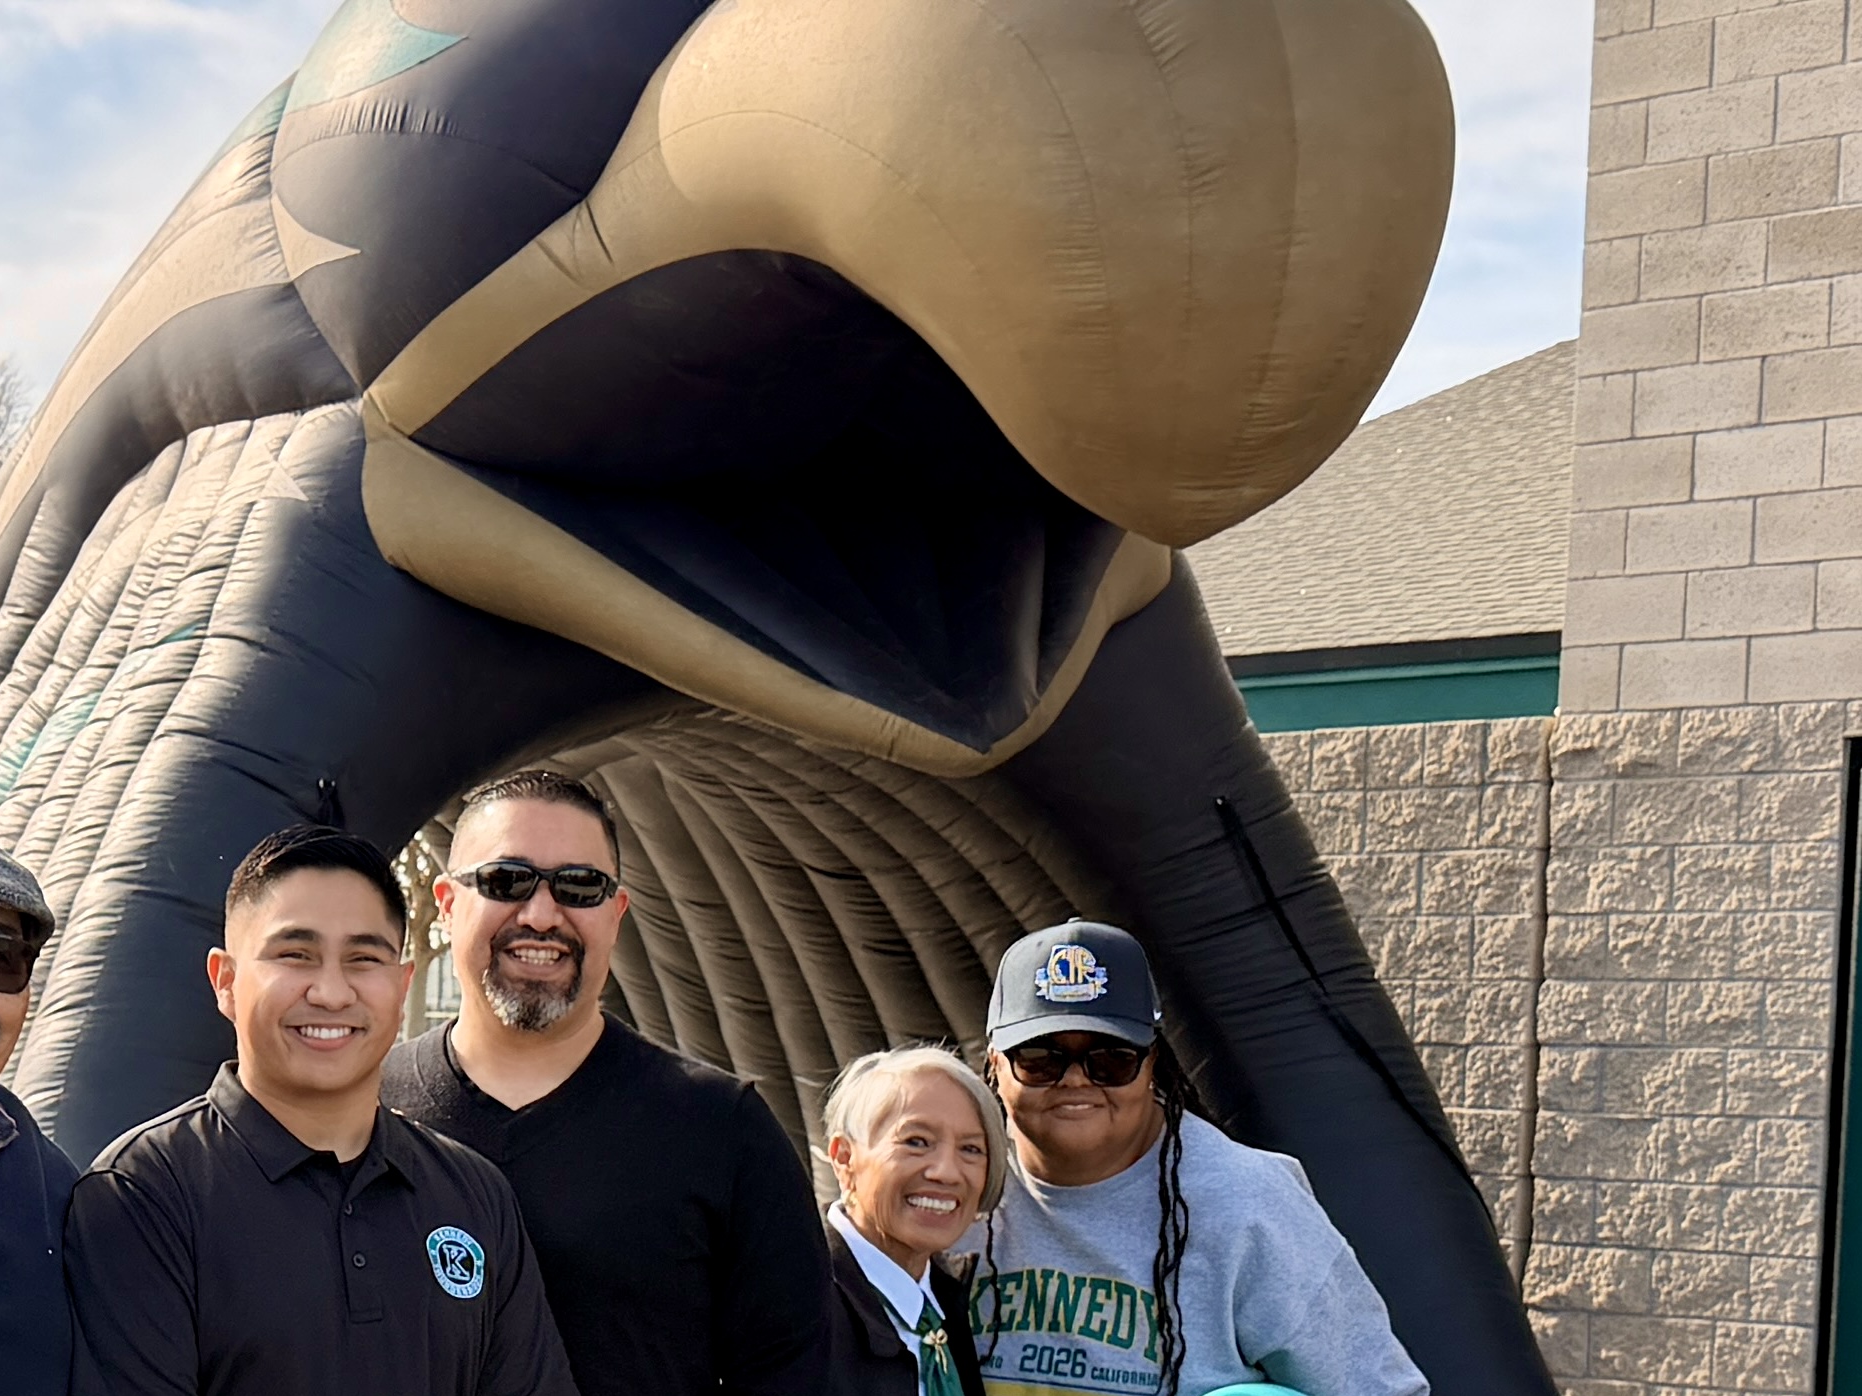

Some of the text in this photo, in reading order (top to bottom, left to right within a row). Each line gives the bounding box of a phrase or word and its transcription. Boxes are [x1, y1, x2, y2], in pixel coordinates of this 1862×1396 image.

[1049, 948, 1096, 985] CIF
[442, 1243, 471, 1281] K
[970, 1268, 1159, 1364] KENNEDY
[1019, 1343, 1087, 1379] 2026
[1090, 1365, 1158, 1387] CALIFORNIA
